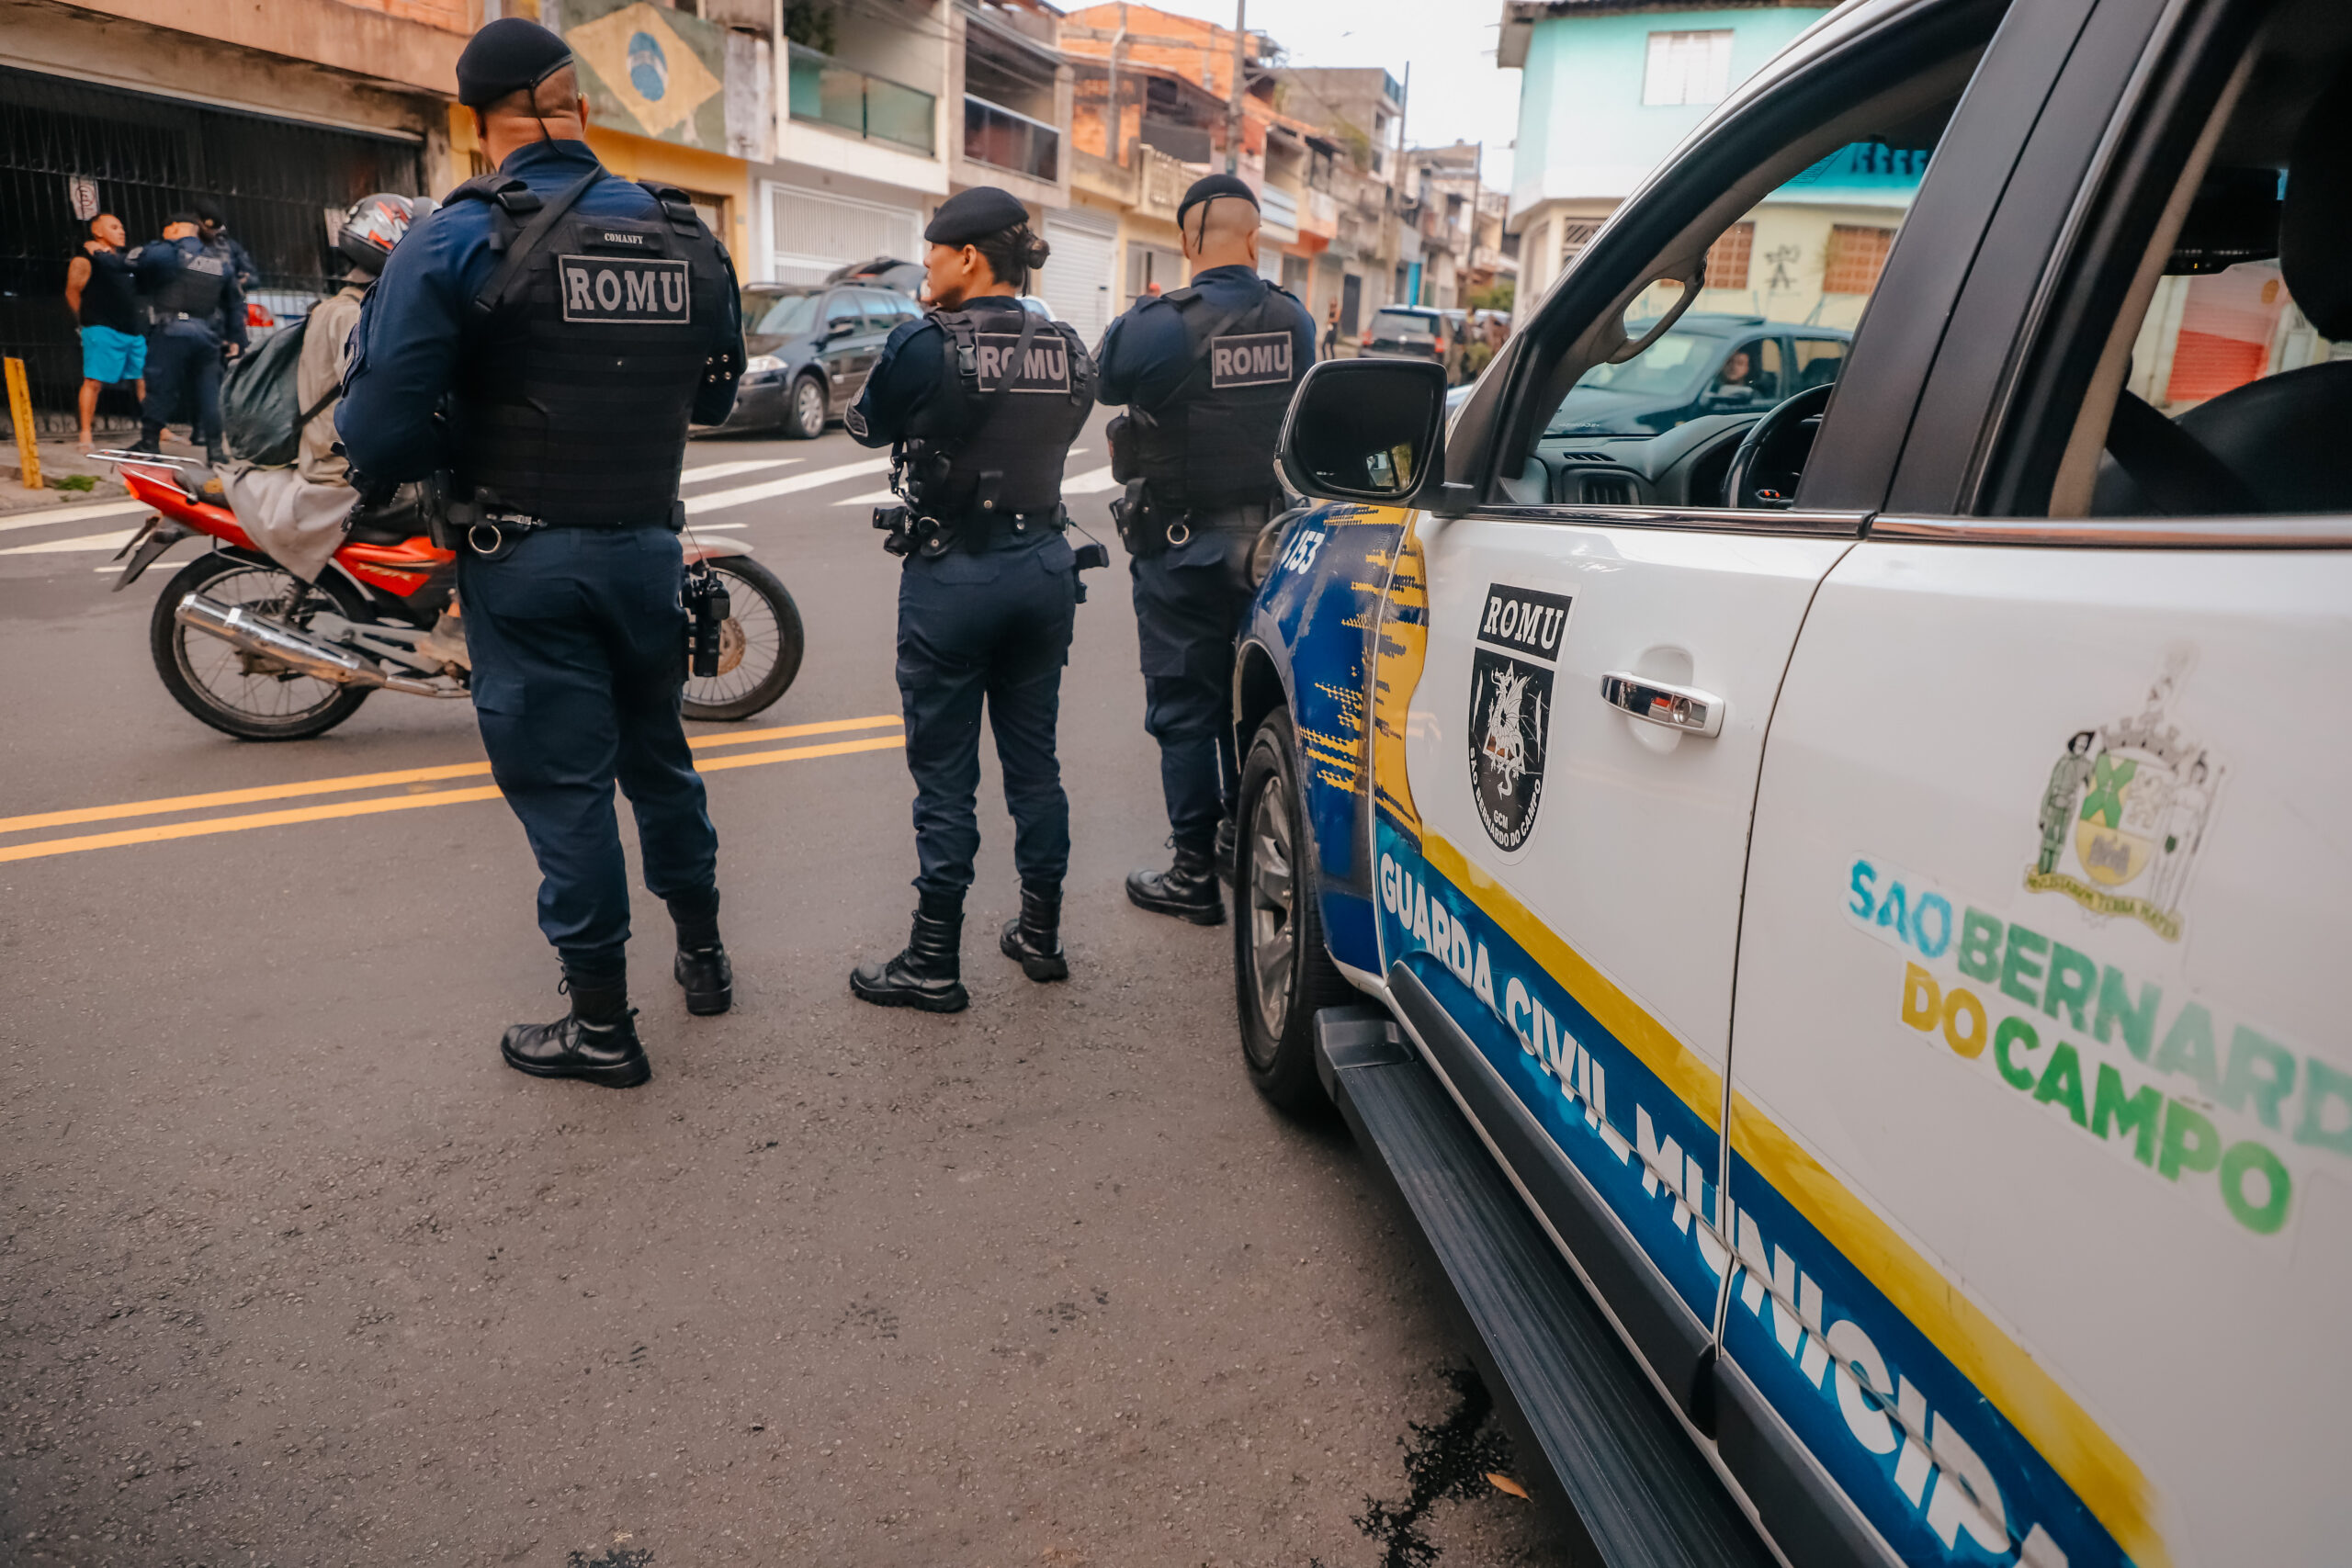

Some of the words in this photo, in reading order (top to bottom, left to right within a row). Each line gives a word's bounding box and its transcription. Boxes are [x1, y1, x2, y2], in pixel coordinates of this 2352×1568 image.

[566, 267, 684, 312] ROMU
[1215, 344, 1290, 378] ROMU
[1483, 595, 1565, 650] ROMU
[1476, 785, 1510, 847] BERNARDO
[1510, 829, 1521, 847] DO
[1521, 778, 1541, 837] CAMPO
[1493, 809, 1509, 830] GCM
[1380, 852, 1505, 1025] GUARDA
[1505, 976, 1631, 1167] CIVIL
[1901, 961, 1988, 1059] DO
[1993, 1016, 2292, 1235] CAMPO
